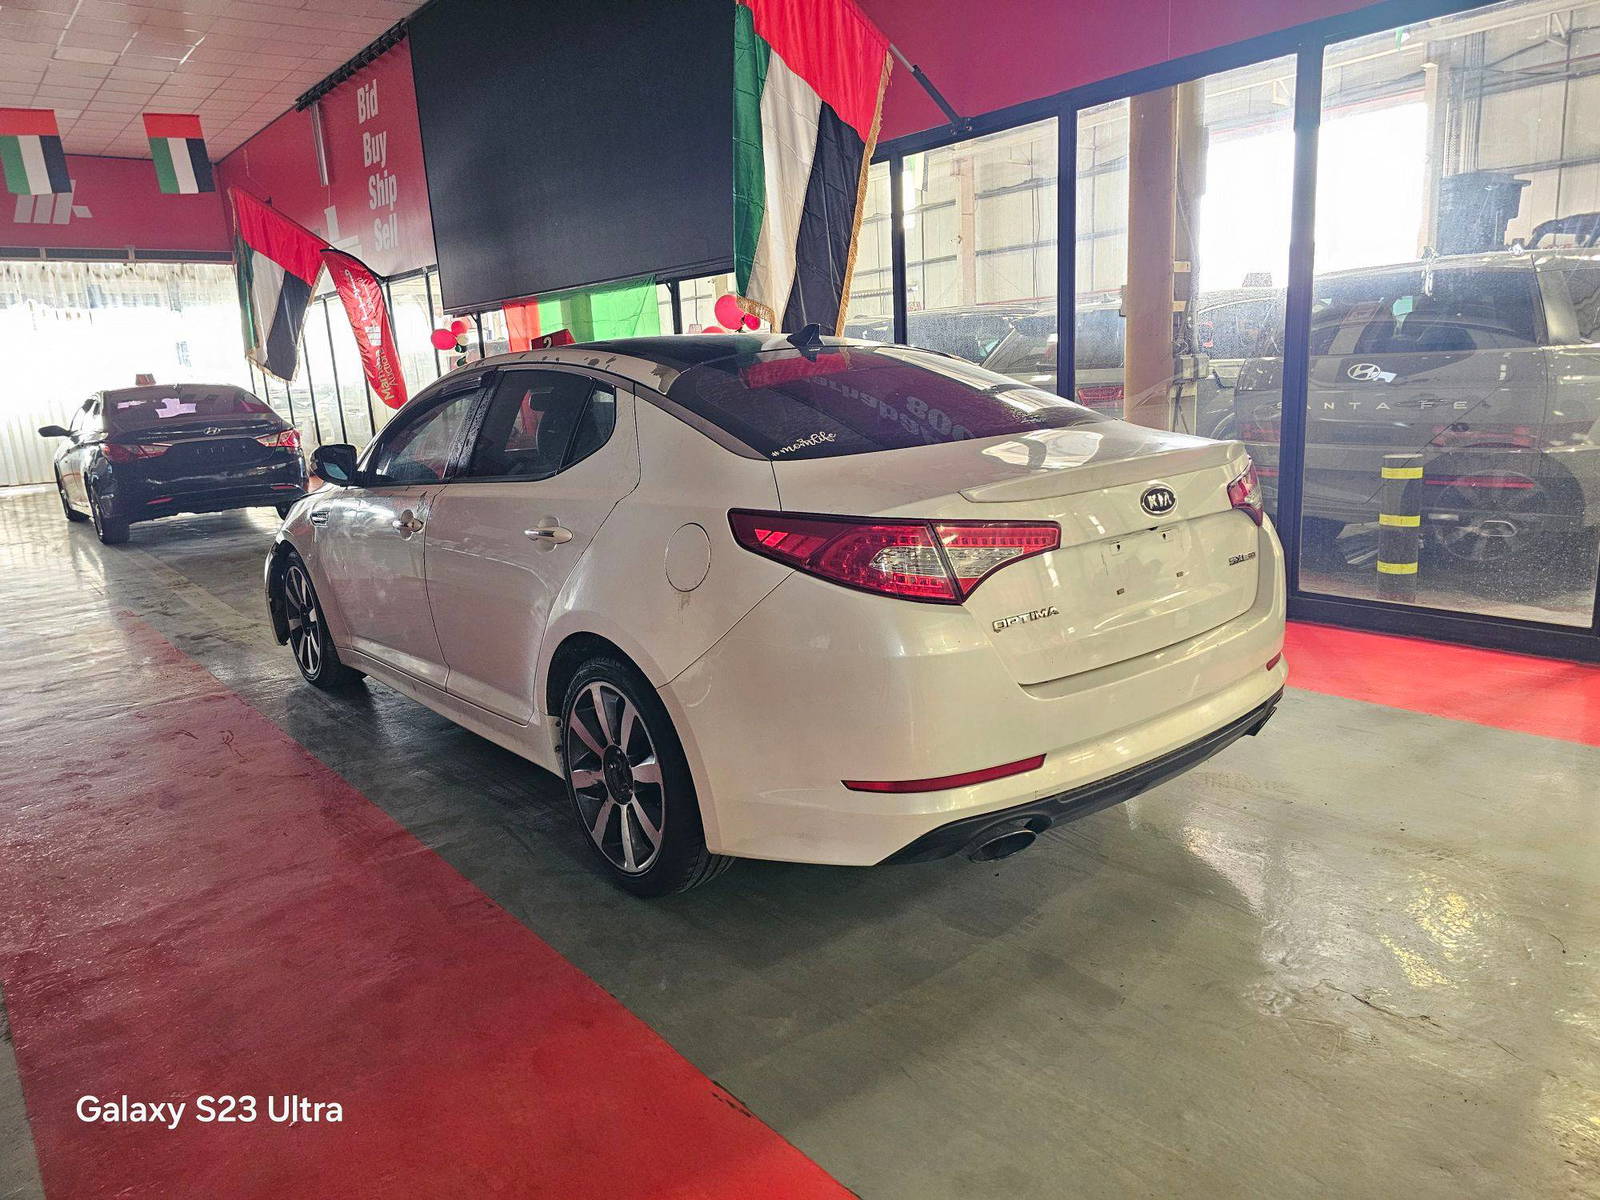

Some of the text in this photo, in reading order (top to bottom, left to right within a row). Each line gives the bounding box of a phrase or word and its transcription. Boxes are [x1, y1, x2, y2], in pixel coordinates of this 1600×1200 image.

[357, 79, 379, 124] Bid
[363, 131, 387, 168] Buy
[369, 169, 397, 211] Ship
[374, 213, 398, 251] Sell
[992, 606, 1060, 633] OPTIMA
